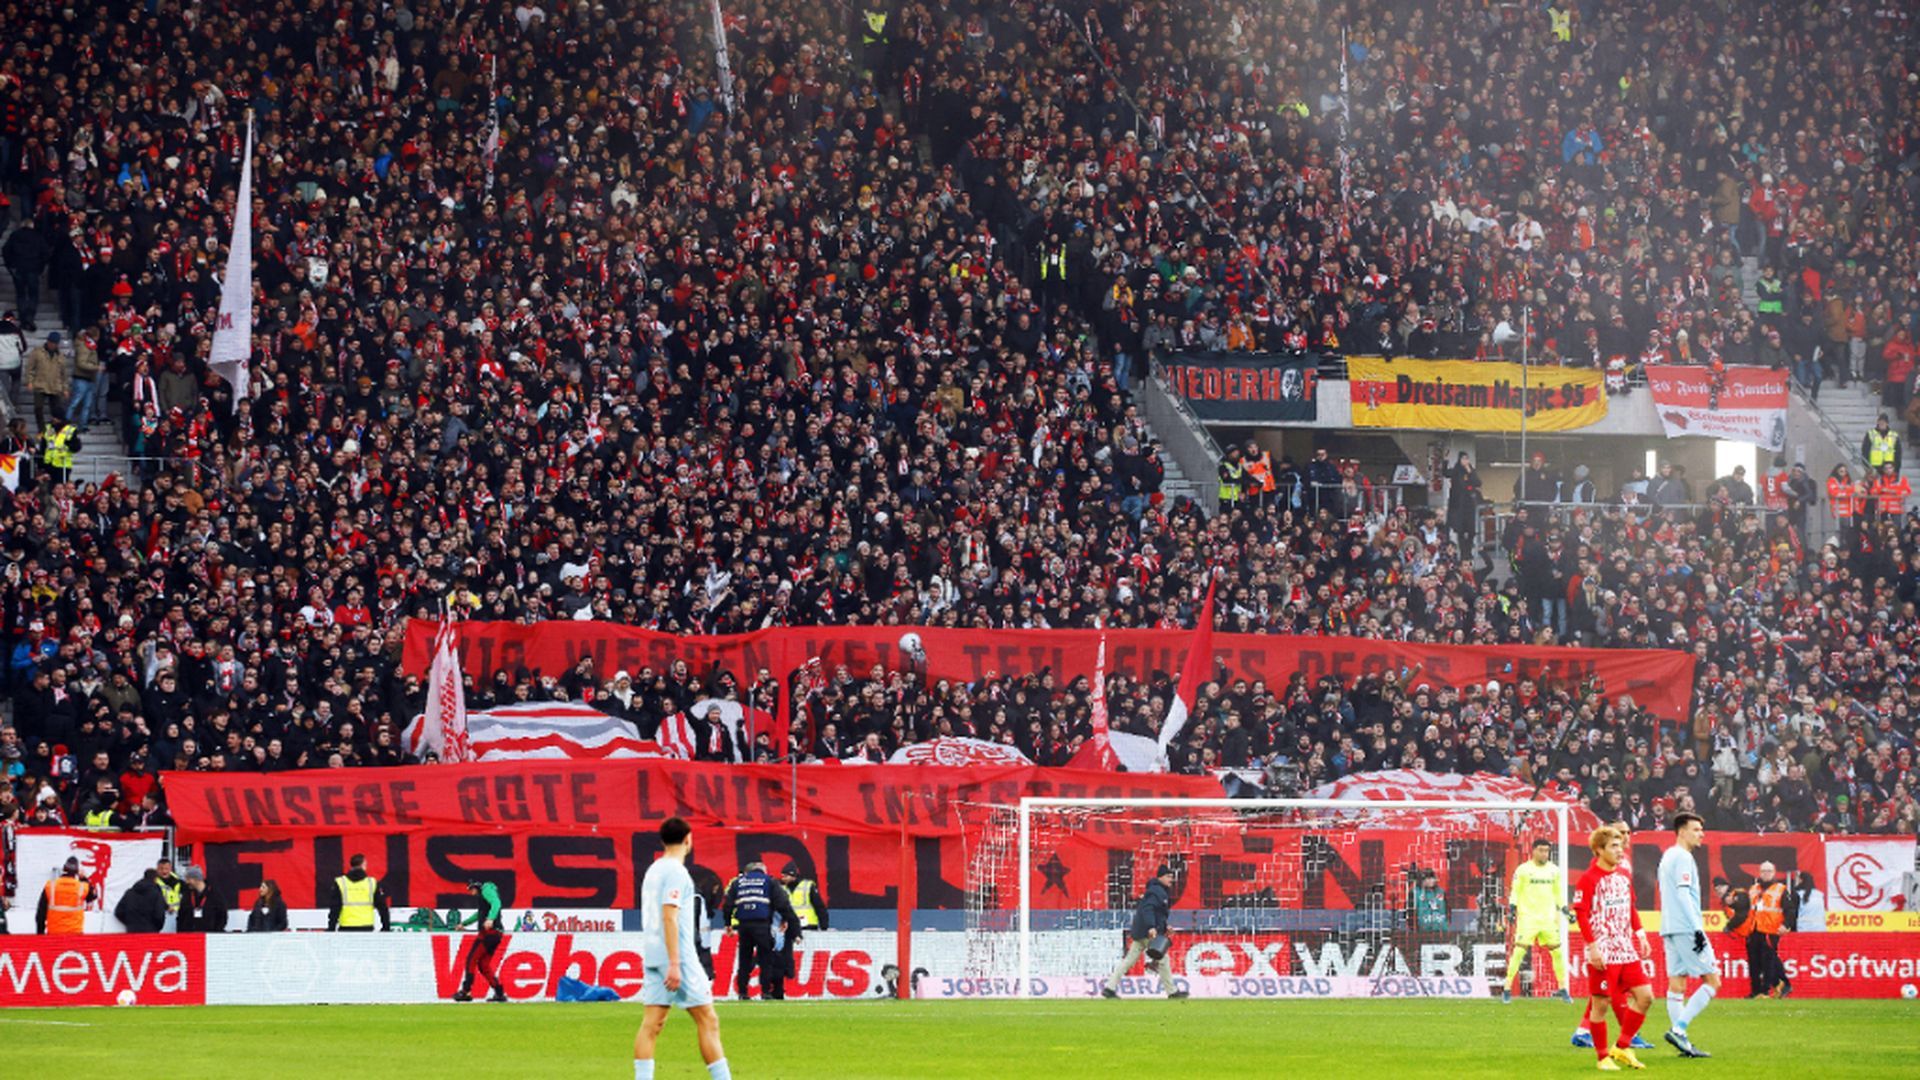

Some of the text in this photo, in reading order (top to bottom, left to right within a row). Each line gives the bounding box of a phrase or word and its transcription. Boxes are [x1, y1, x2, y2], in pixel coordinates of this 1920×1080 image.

[1397, 374, 1585, 417] Dreisam Magic 95
[963, 645, 1063, 690] TEIL
[1114, 646, 1266, 692] EUES
[203, 780, 423, 828] UNSERE
[457, 773, 600, 823] ROTE
[1843, 914, 1884, 927] LOTTO
[0, 950, 188, 994] mewa
[1229, 978, 1332, 996] JOBRAD
[1371, 978, 1472, 996] JOBRAD
